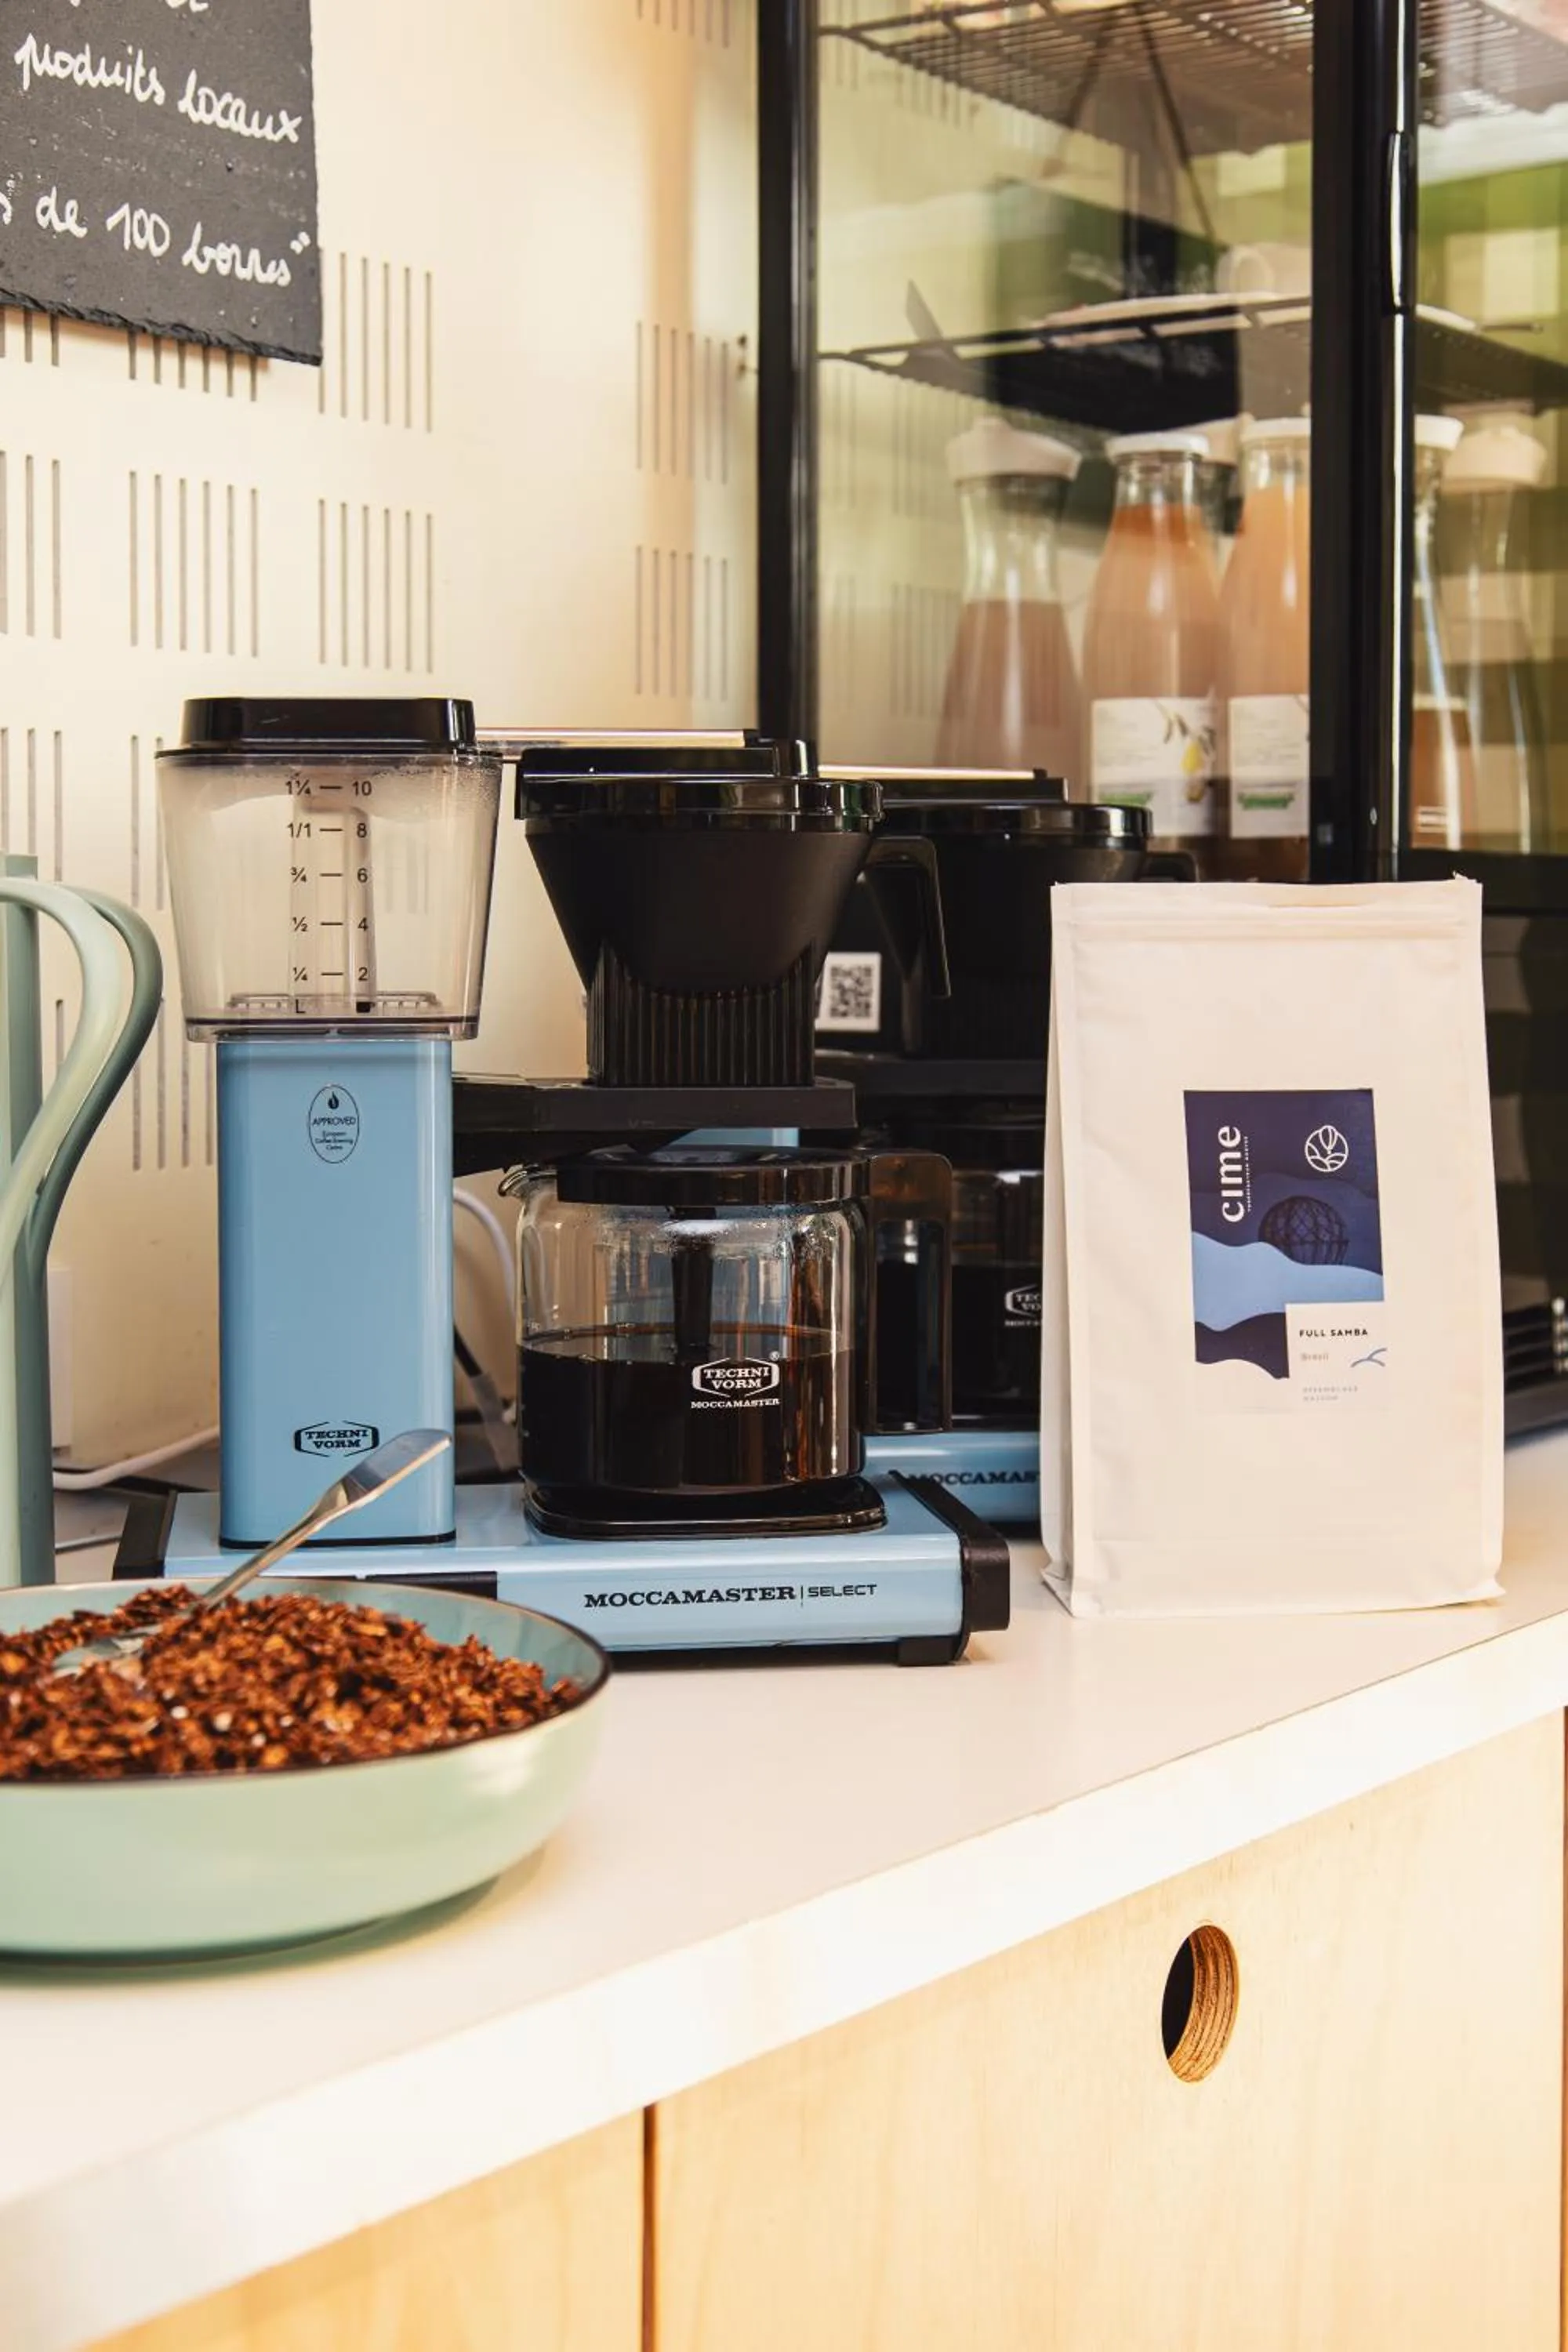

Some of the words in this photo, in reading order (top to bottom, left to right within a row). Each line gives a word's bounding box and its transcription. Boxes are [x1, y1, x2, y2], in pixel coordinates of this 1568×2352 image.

[14, 32, 165, 106] produits
[177, 69, 303, 143] locaux
[35, 185, 88, 238] de
[106, 202, 170, 256] 100
[352, 781, 372, 797] 10
[287, 822, 311, 838] 1/1
[357, 822, 368, 838] 8
[357, 868, 368, 884] 6
[358, 918, 368, 931] 4
[358, 967, 368, 981] 2
[1218, 1125, 1245, 1222] cime
[1330, 1328, 1368, 1337] SAMBA
[703, 1367, 770, 1379] TECHNI
[712, 1379, 762, 1389] VORM
[691, 1398, 780, 1409] MOCCAMASTER
[305, 1429, 368, 1439] TECHNI
[313, 1439, 361, 1449] VORM
[584, 1587, 795, 1608] MOCCAMASTER
[808, 1584, 877, 1598] SELECT
